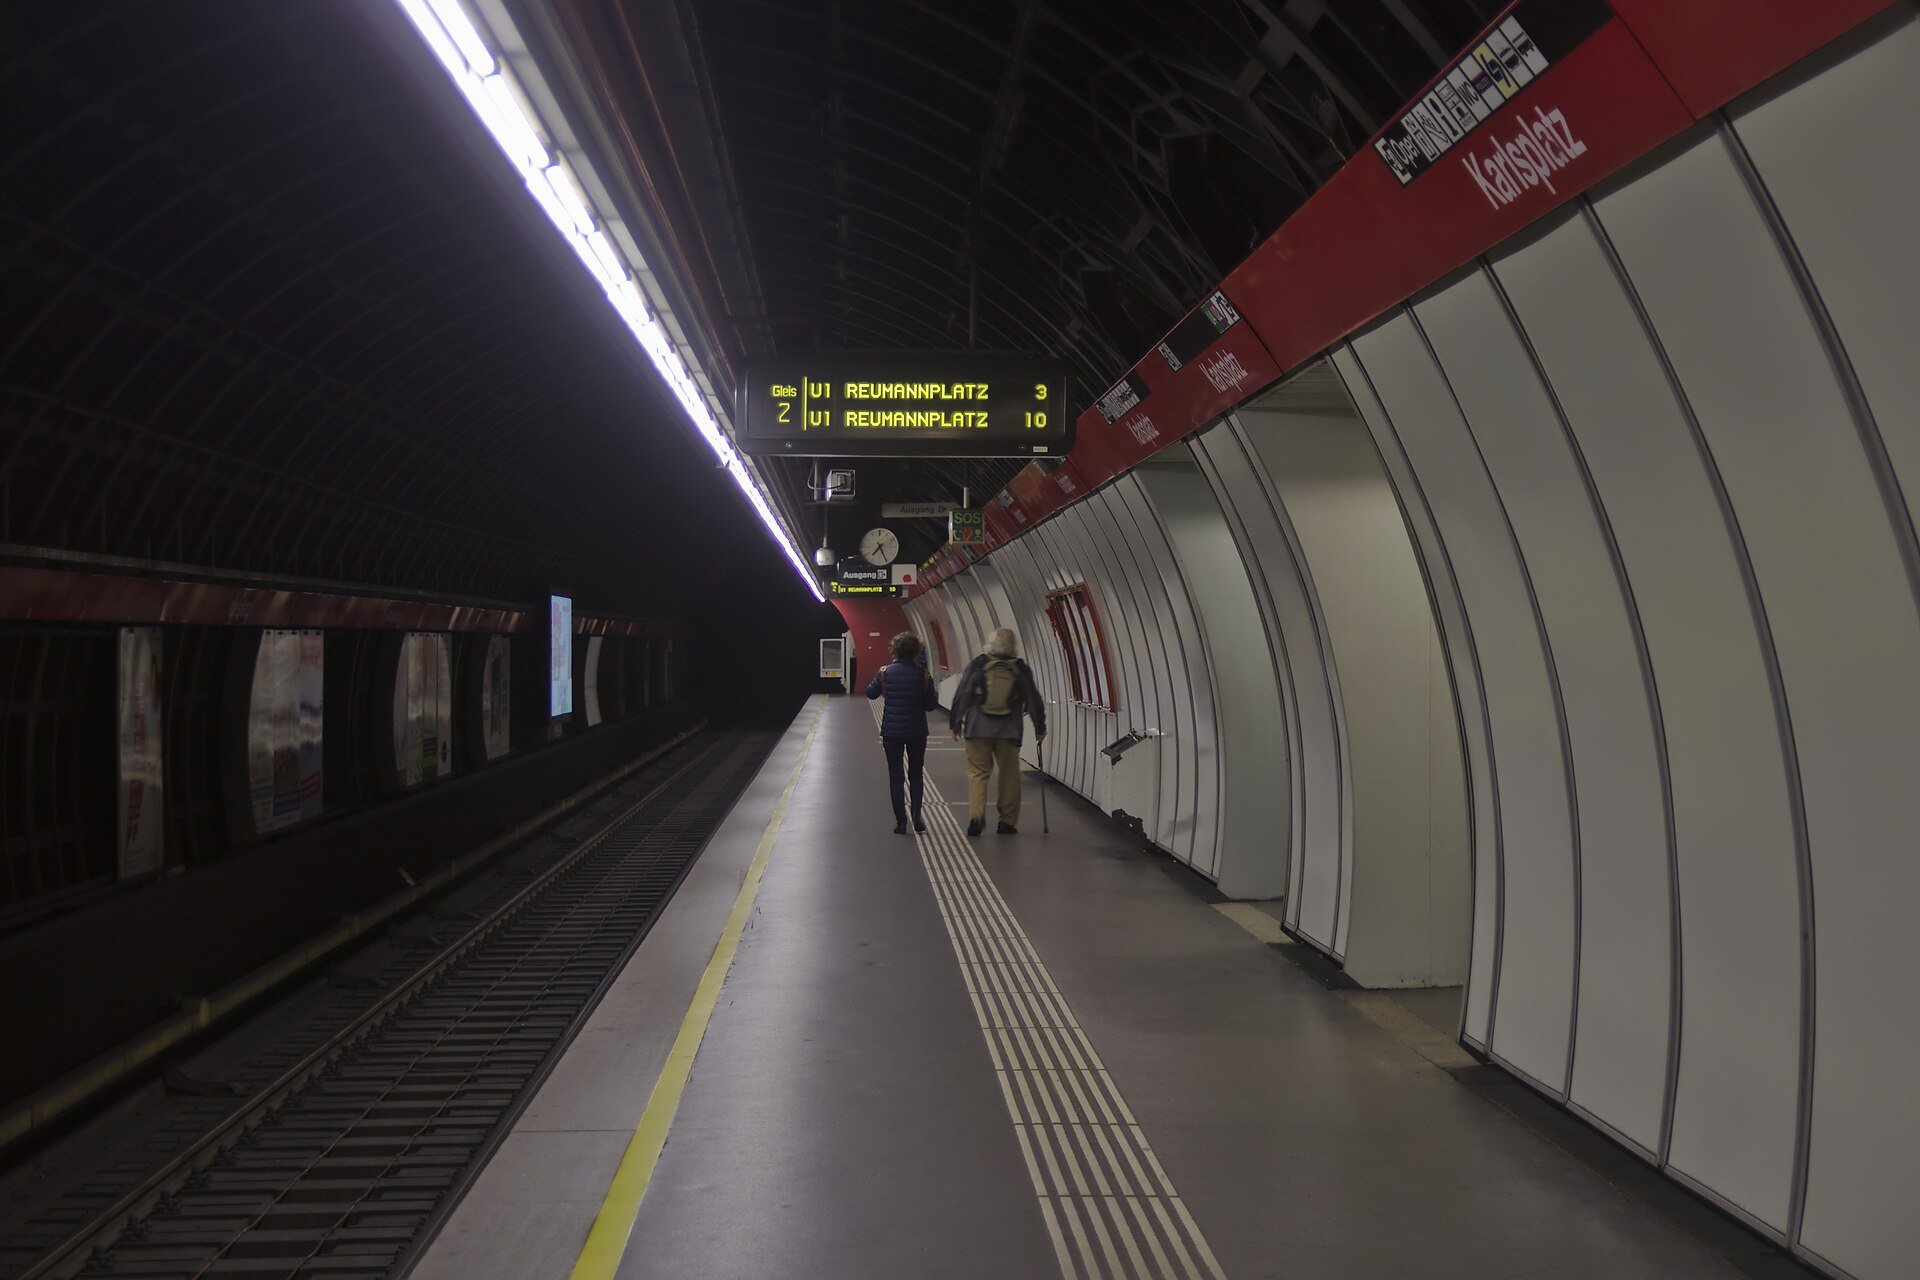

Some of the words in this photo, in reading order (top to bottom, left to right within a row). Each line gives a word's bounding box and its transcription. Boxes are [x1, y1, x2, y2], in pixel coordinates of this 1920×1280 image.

[1456, 81, 1479, 106] WC
[1394, 133, 1420, 168] Oper
[1462, 105, 1588, 210] Karlsplatz
[1199, 349, 1249, 394] Karlsplatz
[771, 385, 797, 398] Gleis
[810, 383, 831, 399] U1
[845, 383, 989, 400] REUMANNPLATZ
[1035, 384, 1048, 400] 3
[778, 403, 790, 423] 2
[810, 411, 831, 427] U1
[845, 411, 989, 428] REUMANNPLATZ
[1025, 412, 1048, 428] 10
[900, 505, 935, 514] Ausgang
[954, 512, 981, 524] SOS
[843, 570, 876, 579] Ausgang
